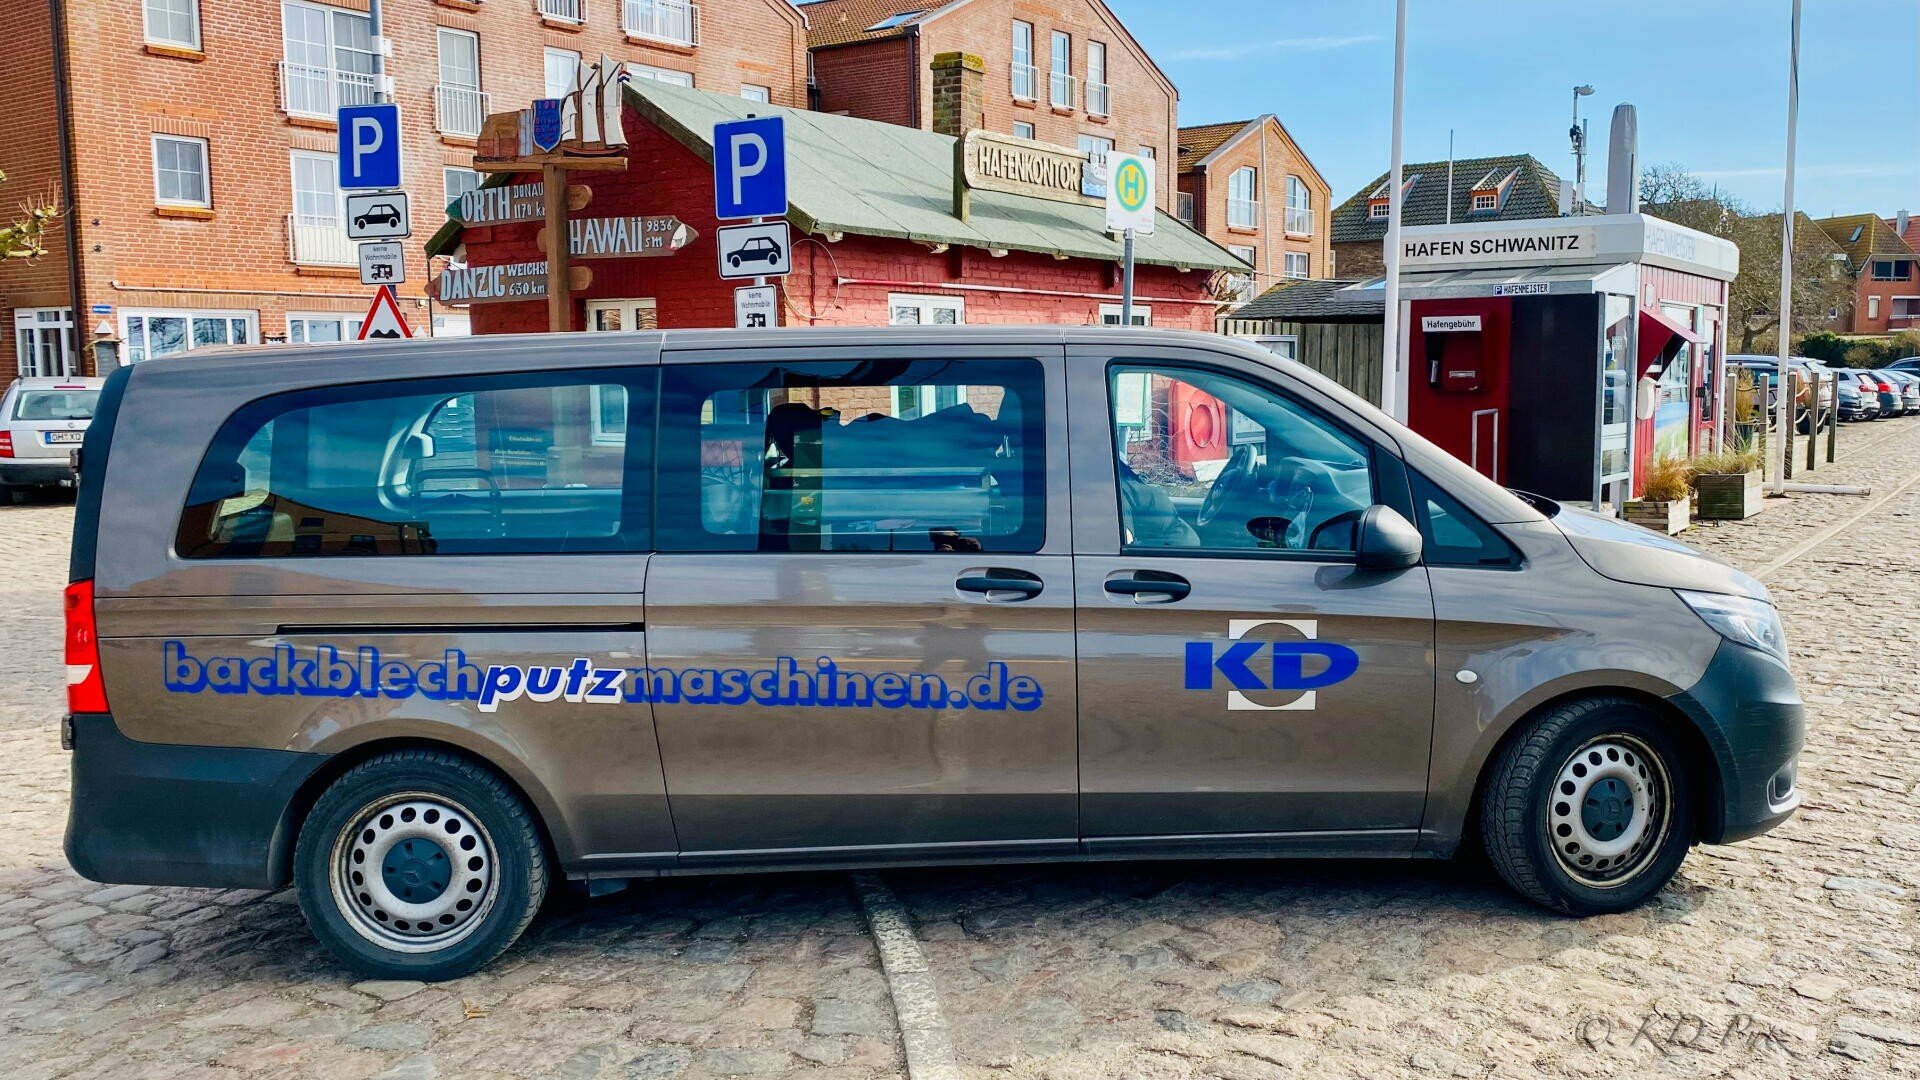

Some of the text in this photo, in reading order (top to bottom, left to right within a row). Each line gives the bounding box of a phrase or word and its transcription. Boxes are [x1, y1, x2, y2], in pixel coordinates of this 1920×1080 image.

[352, 117, 383, 177] P
[731, 133, 768, 205] P
[978, 144, 1079, 192] HAFENKONTOR
[1124, 169, 1140, 199] H
[461, 186, 511, 222] ORTH
[513, 182, 544, 199] DONAU
[646, 219, 673, 233] 9836
[1405, 235, 1579, 258] HAFEN SCHWANITZ
[440, 265, 506, 301] DANZIG
[508, 280, 545, 296] 630 km
[1503, 283, 1549, 295] HAFENMEISTER
[1426, 320, 1476, 330] Hafengebühr
[164, 640, 1044, 713] backblechputzmaschinen.de
[1183, 642, 1359, 690] KD
